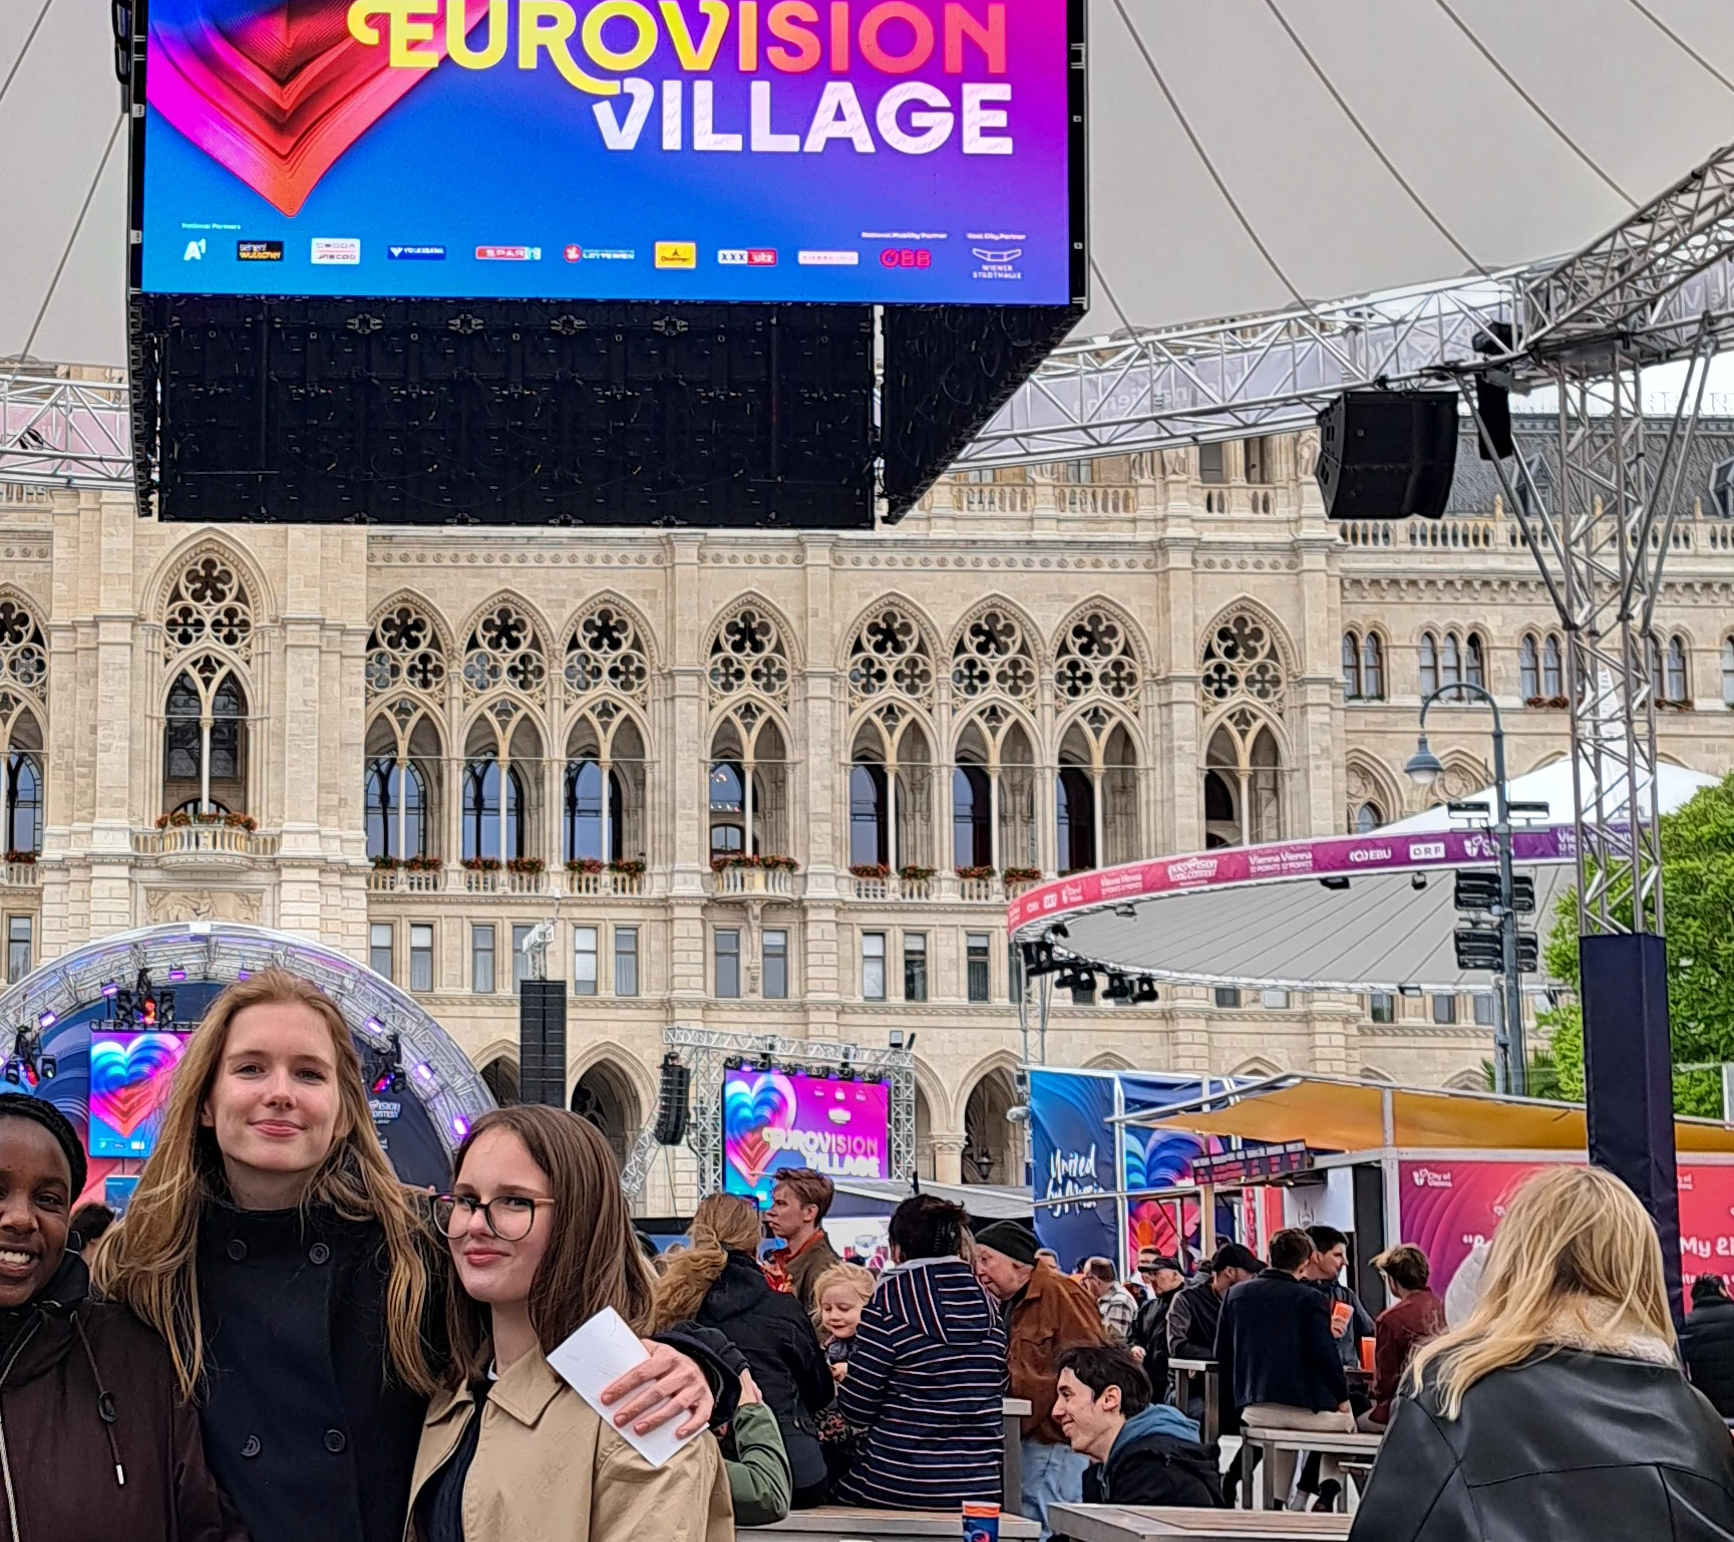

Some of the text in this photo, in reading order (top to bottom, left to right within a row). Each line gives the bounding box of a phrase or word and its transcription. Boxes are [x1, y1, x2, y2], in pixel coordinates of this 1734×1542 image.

[592, 77, 1014, 155] VILLAGE
[1369, 847, 1392, 860] EBU
[1413, 845, 1442, 856] ORF
[1050, 1143, 1098, 1185] United
